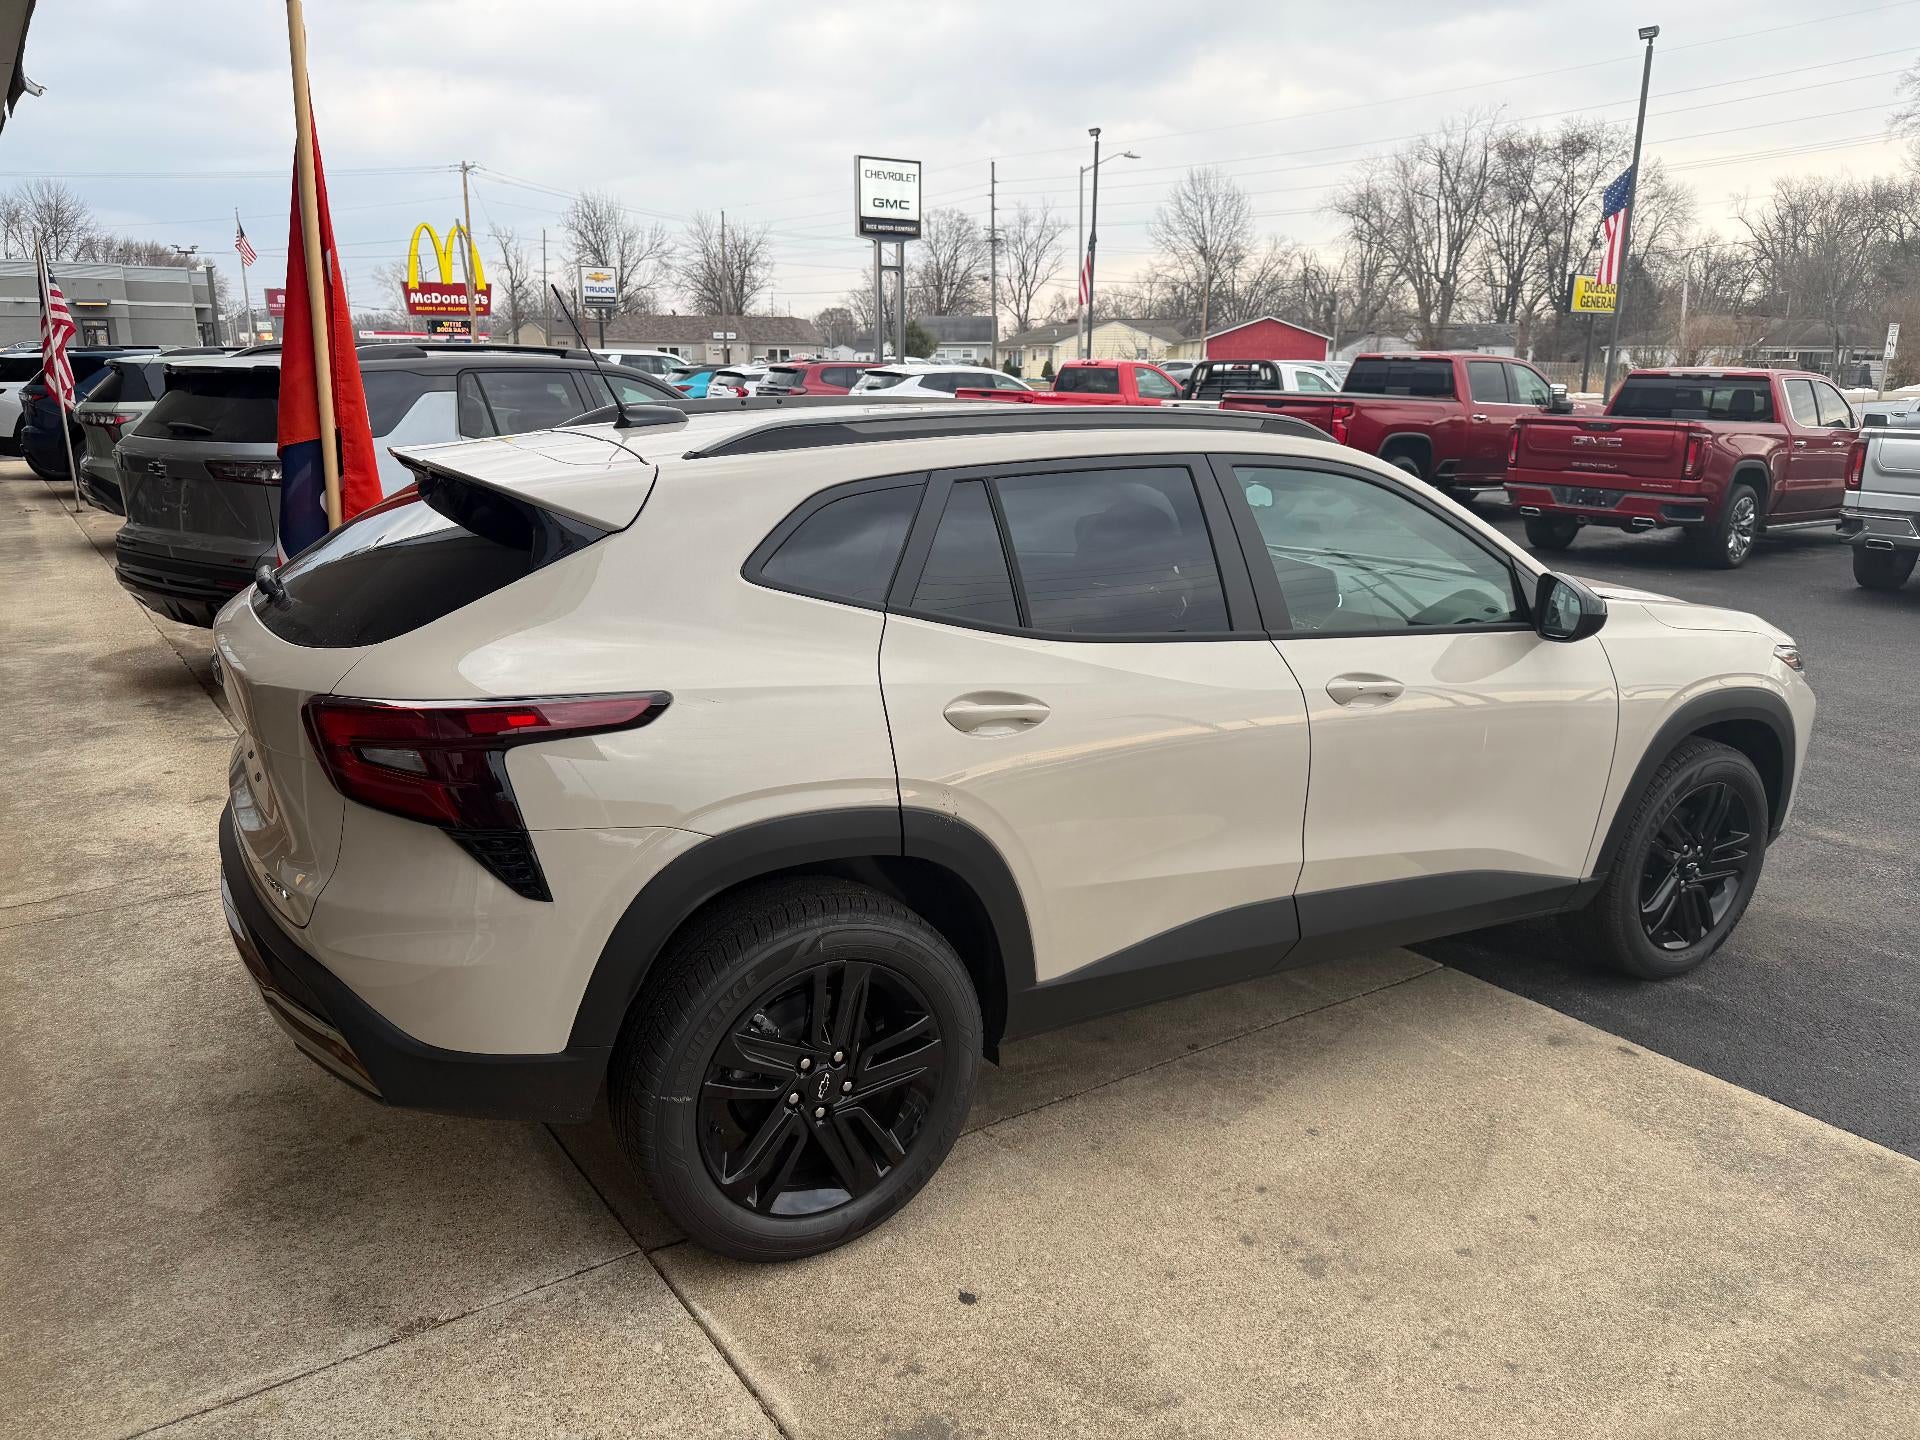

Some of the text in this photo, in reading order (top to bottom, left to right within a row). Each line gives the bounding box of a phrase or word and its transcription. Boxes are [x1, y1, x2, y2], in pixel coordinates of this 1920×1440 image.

[865, 170, 916, 182] CHEVROLET
[873, 198, 910, 210] GMC
[1584, 281, 1616, 294] DOLLAR
[410, 292, 489, 305] McDonad's
[1580, 296, 1616, 308] GENERAL
[1572, 436, 1622, 448] GMC
